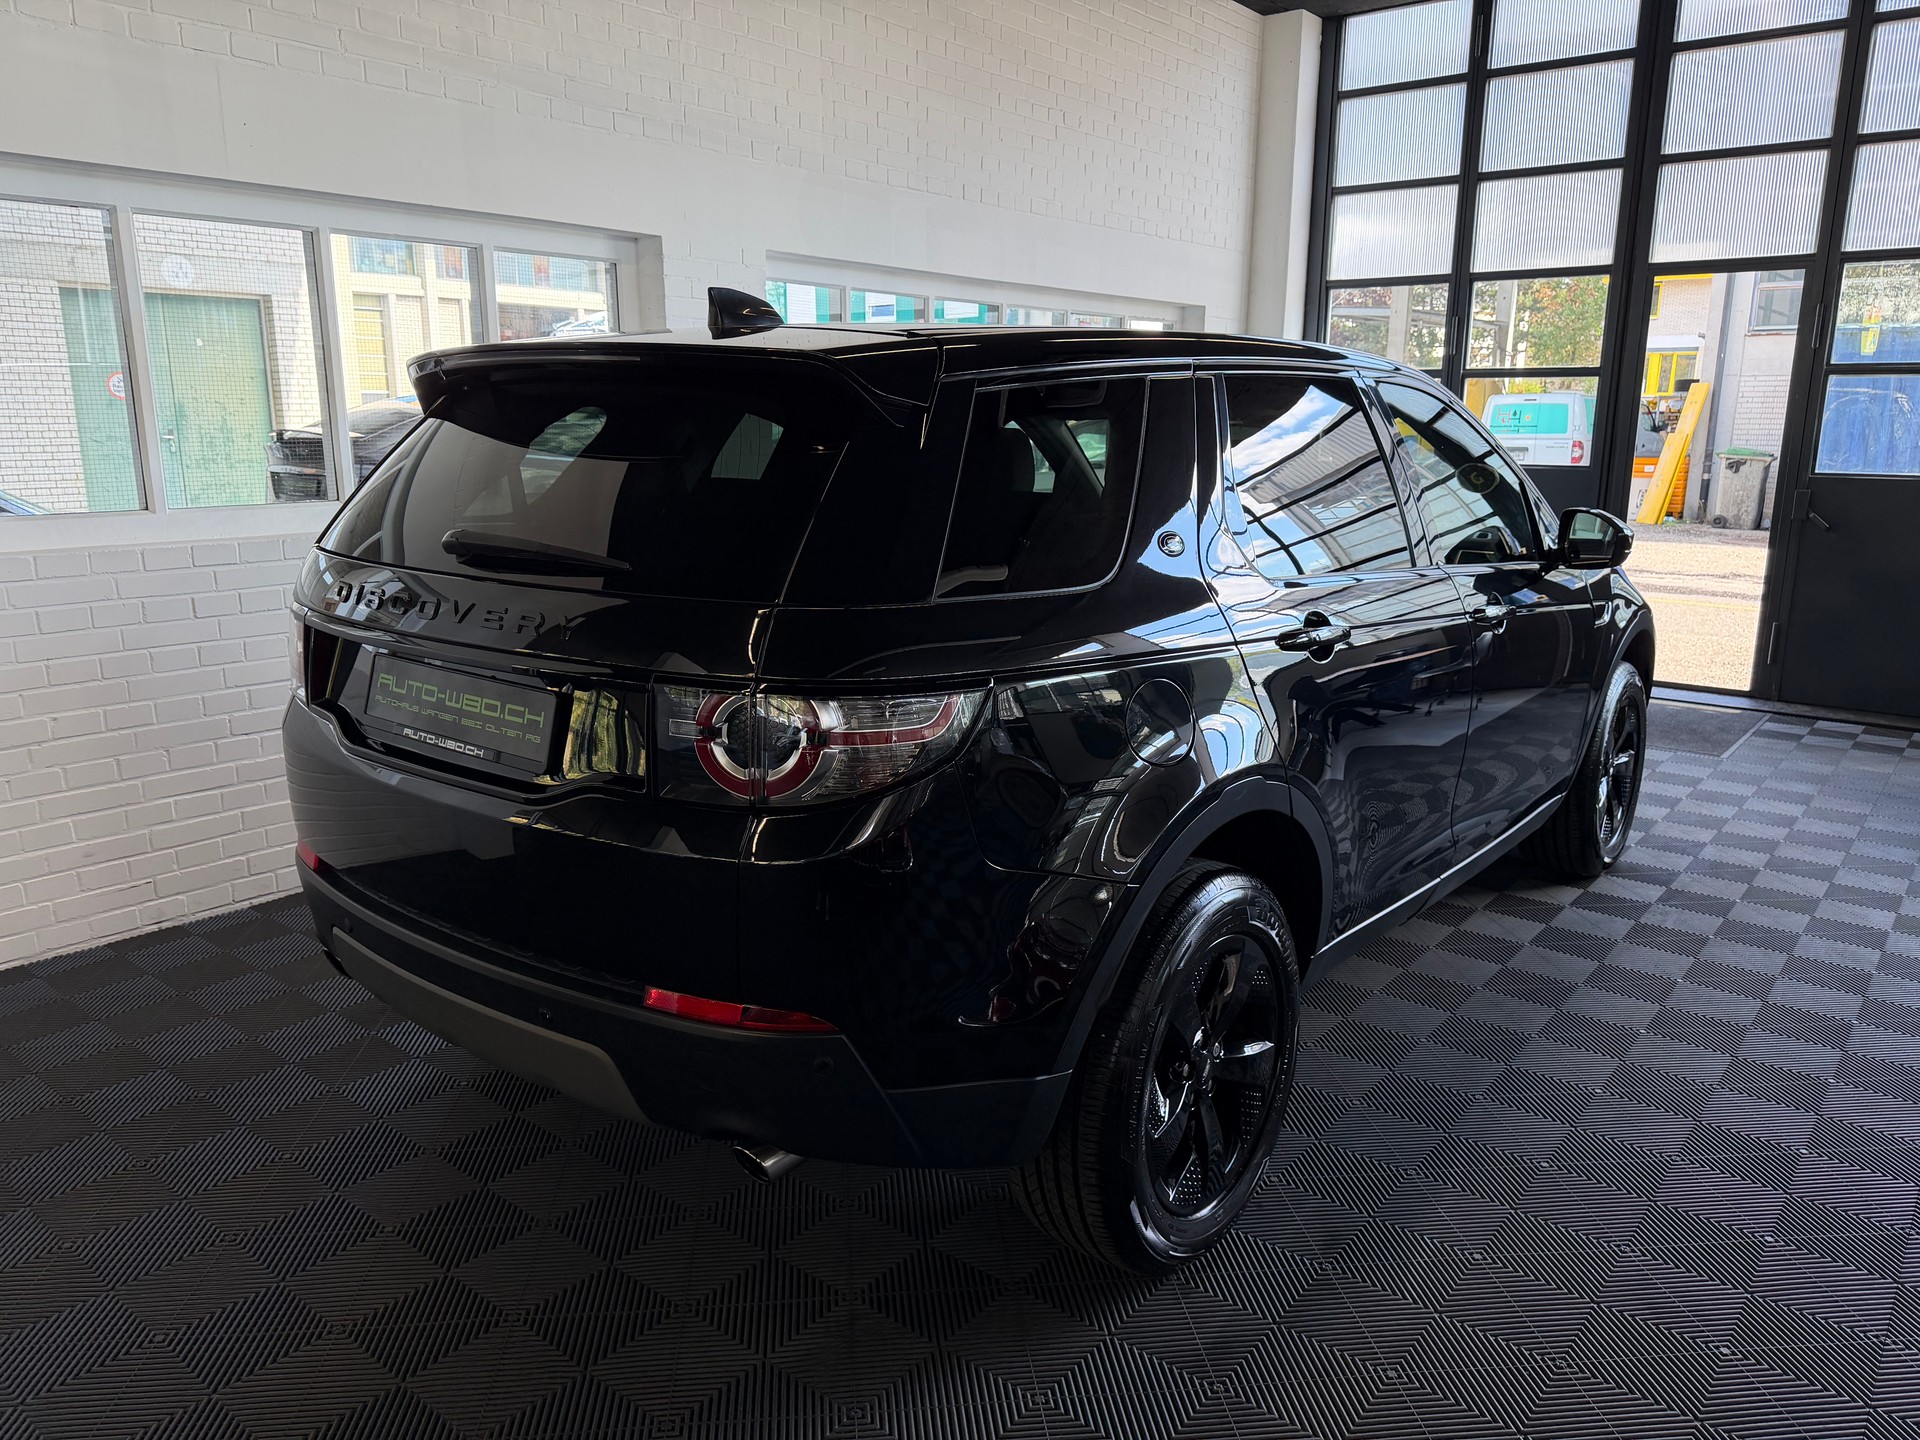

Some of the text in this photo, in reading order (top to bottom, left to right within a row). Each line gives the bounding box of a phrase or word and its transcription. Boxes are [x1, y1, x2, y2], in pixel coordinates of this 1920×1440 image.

[336, 582, 586, 640] DISCOVERY
[375, 694, 420, 713] AUTOHAUS
[461, 718, 483, 729] BEI
[485, 723, 523, 739] OLTEN
[525, 734, 542, 744] AG
